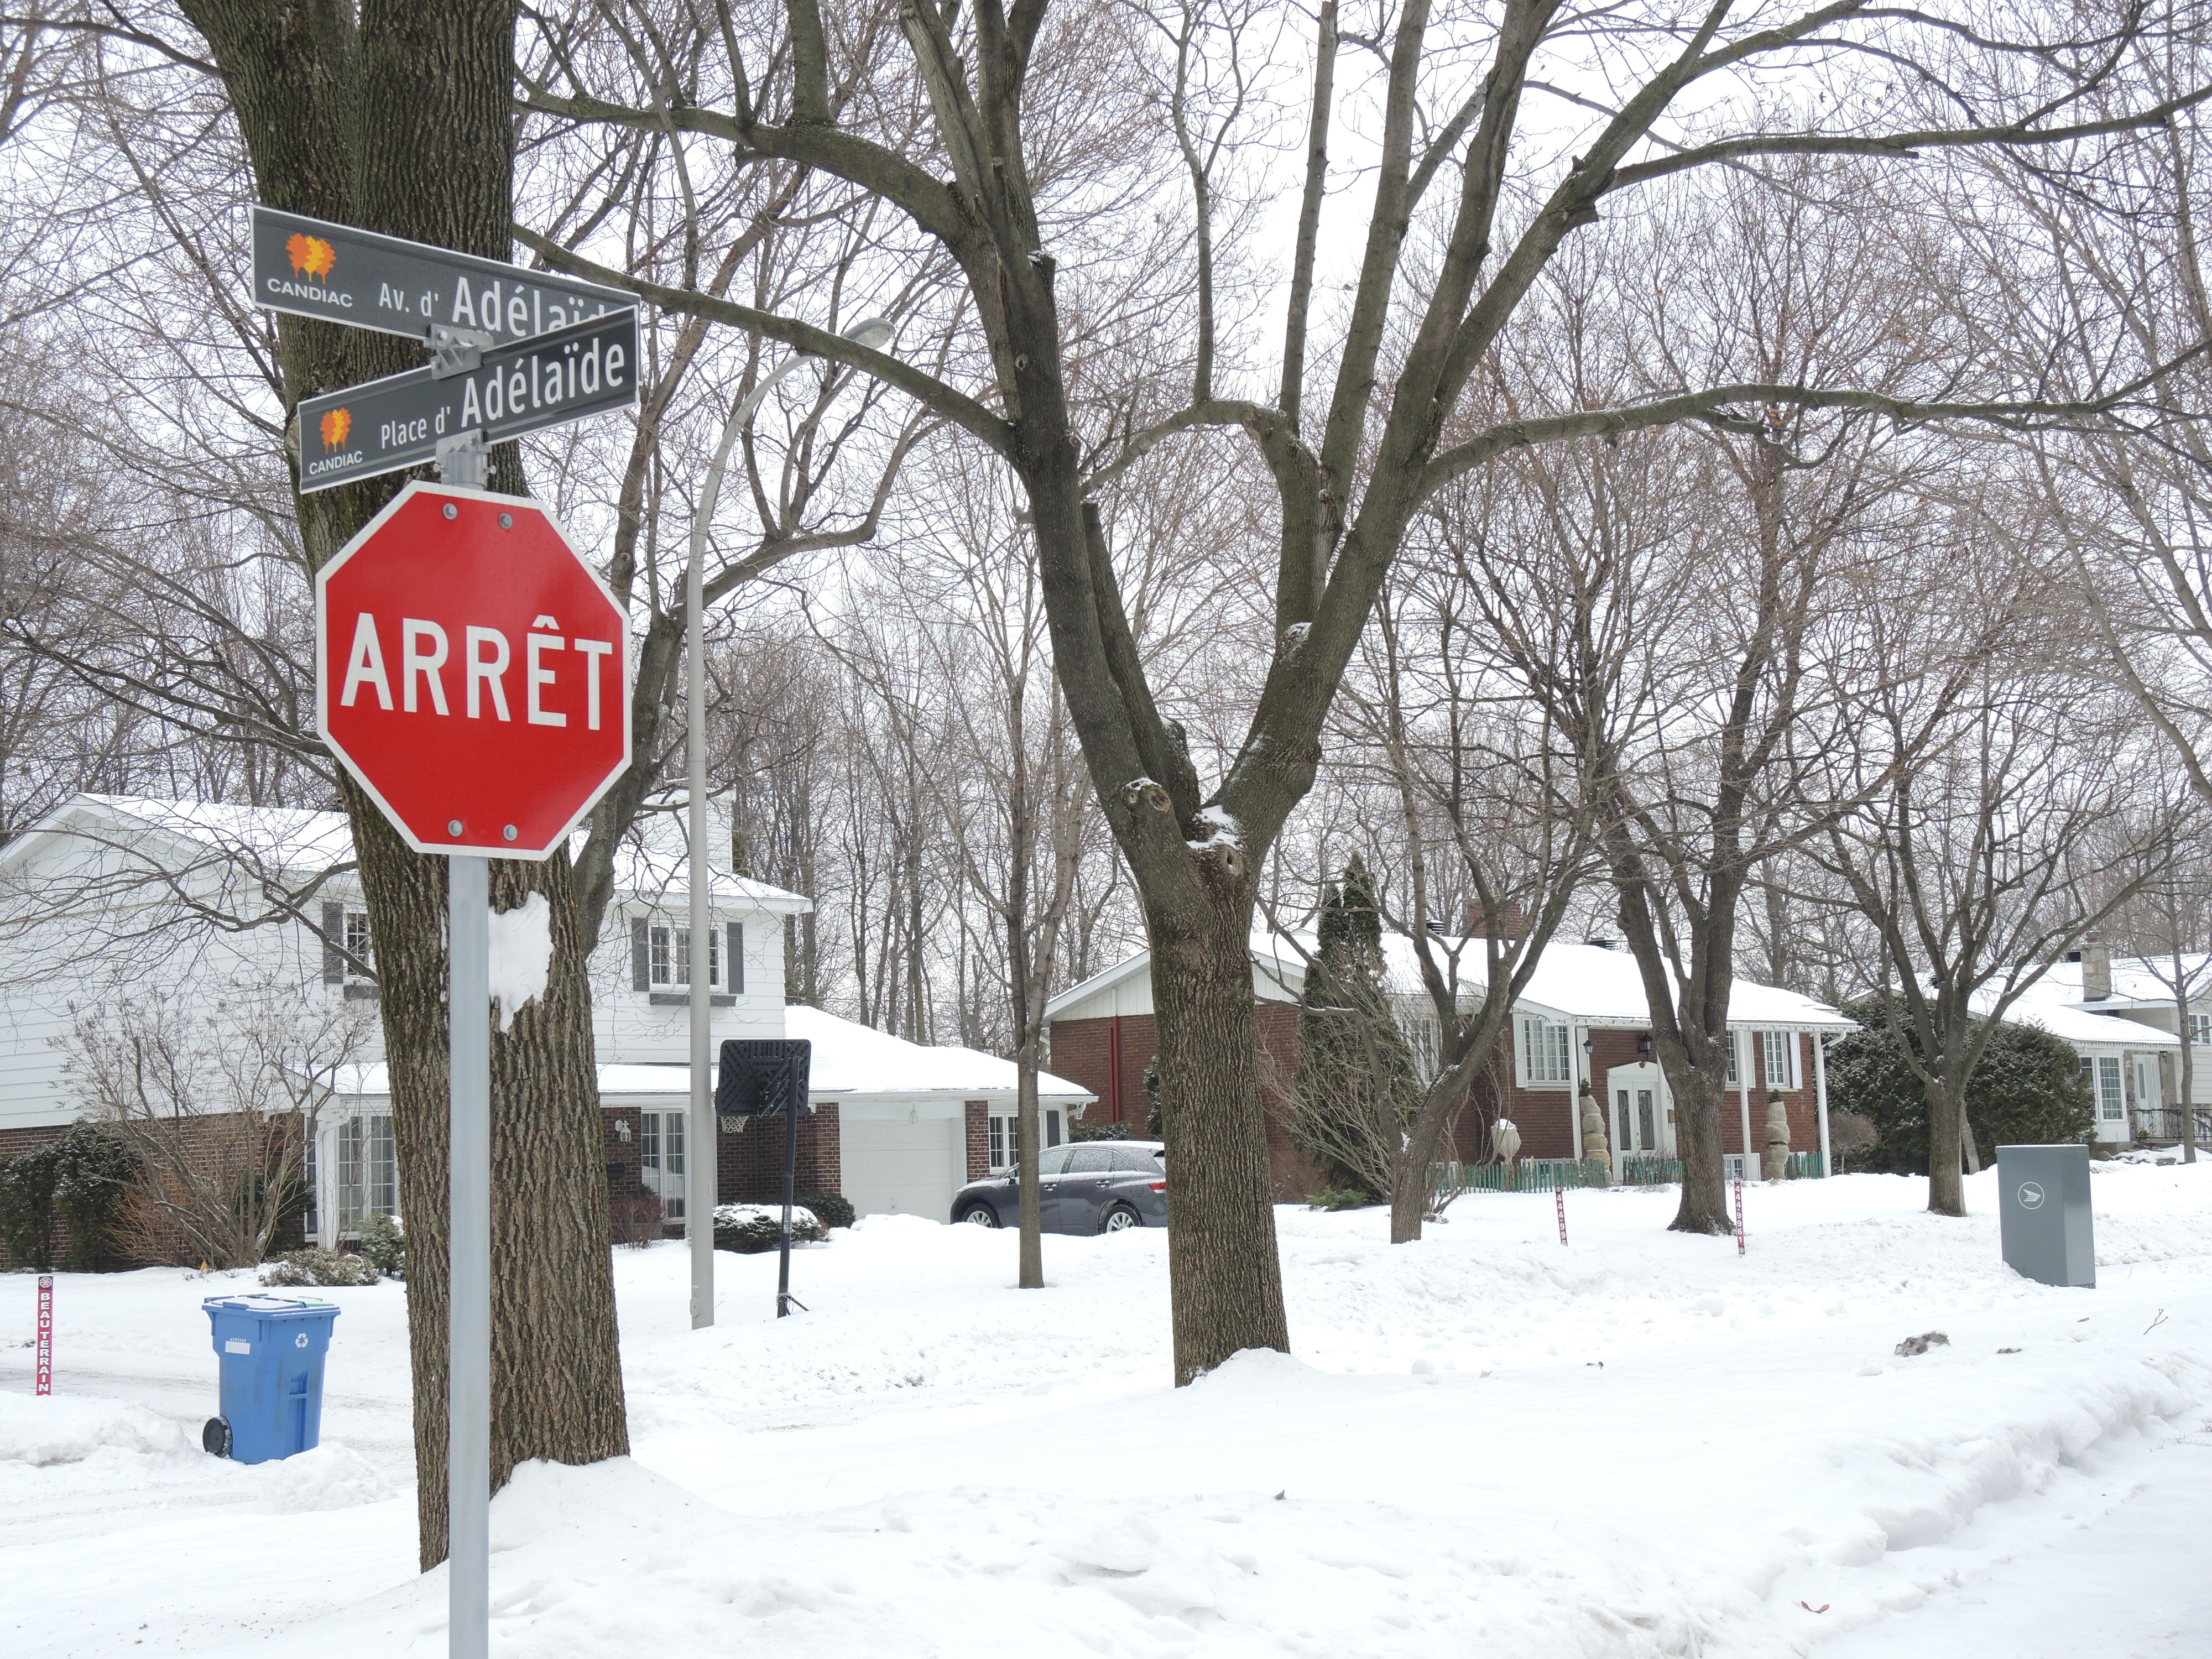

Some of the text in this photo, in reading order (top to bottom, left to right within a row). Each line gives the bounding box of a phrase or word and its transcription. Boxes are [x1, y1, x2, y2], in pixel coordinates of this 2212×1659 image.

[267, 278, 353, 307] CANDIAC
[379, 276, 604, 337] Av. d' Adélaï
[382, 337, 624, 449] Place d' Adélaïde
[309, 451, 363, 474] CANDIAC
[341, 612, 612, 731] ARRÊT
[39, 1293, 50, 1392] BEAU TERRAIN
